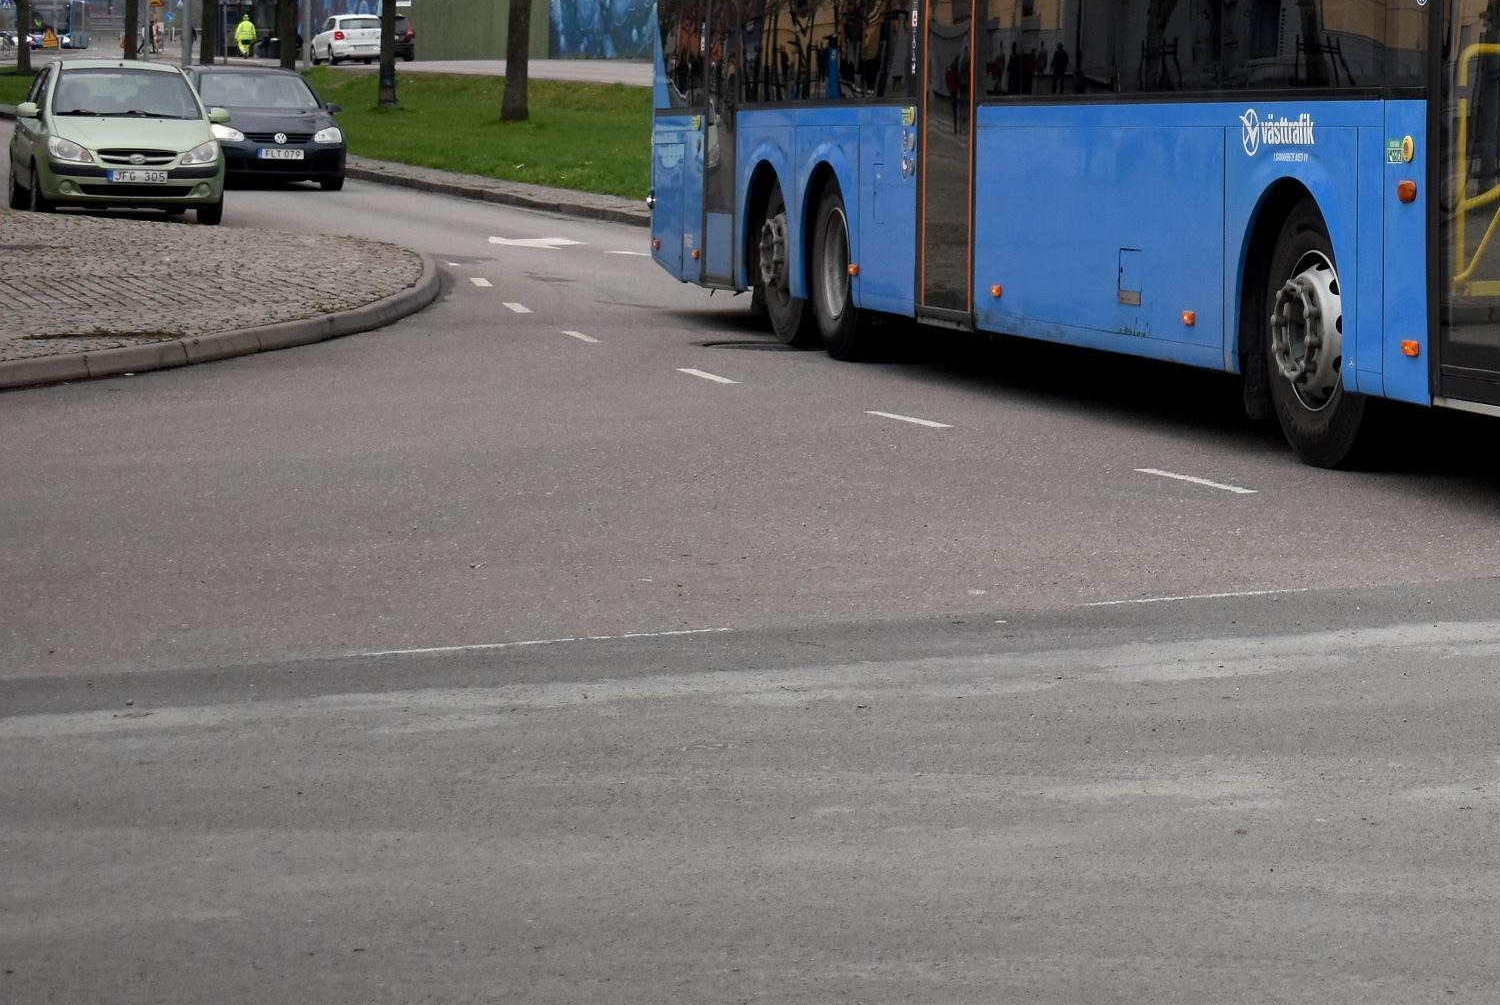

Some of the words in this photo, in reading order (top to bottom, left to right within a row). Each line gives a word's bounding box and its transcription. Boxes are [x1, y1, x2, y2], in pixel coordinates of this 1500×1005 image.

[1261, 113, 1315, 145] västtrafik
[265, 149, 283, 158] FLT
[284, 150, 302, 158] 079
[115, 171, 136, 181] JFG
[144, 171, 166, 182] 305
